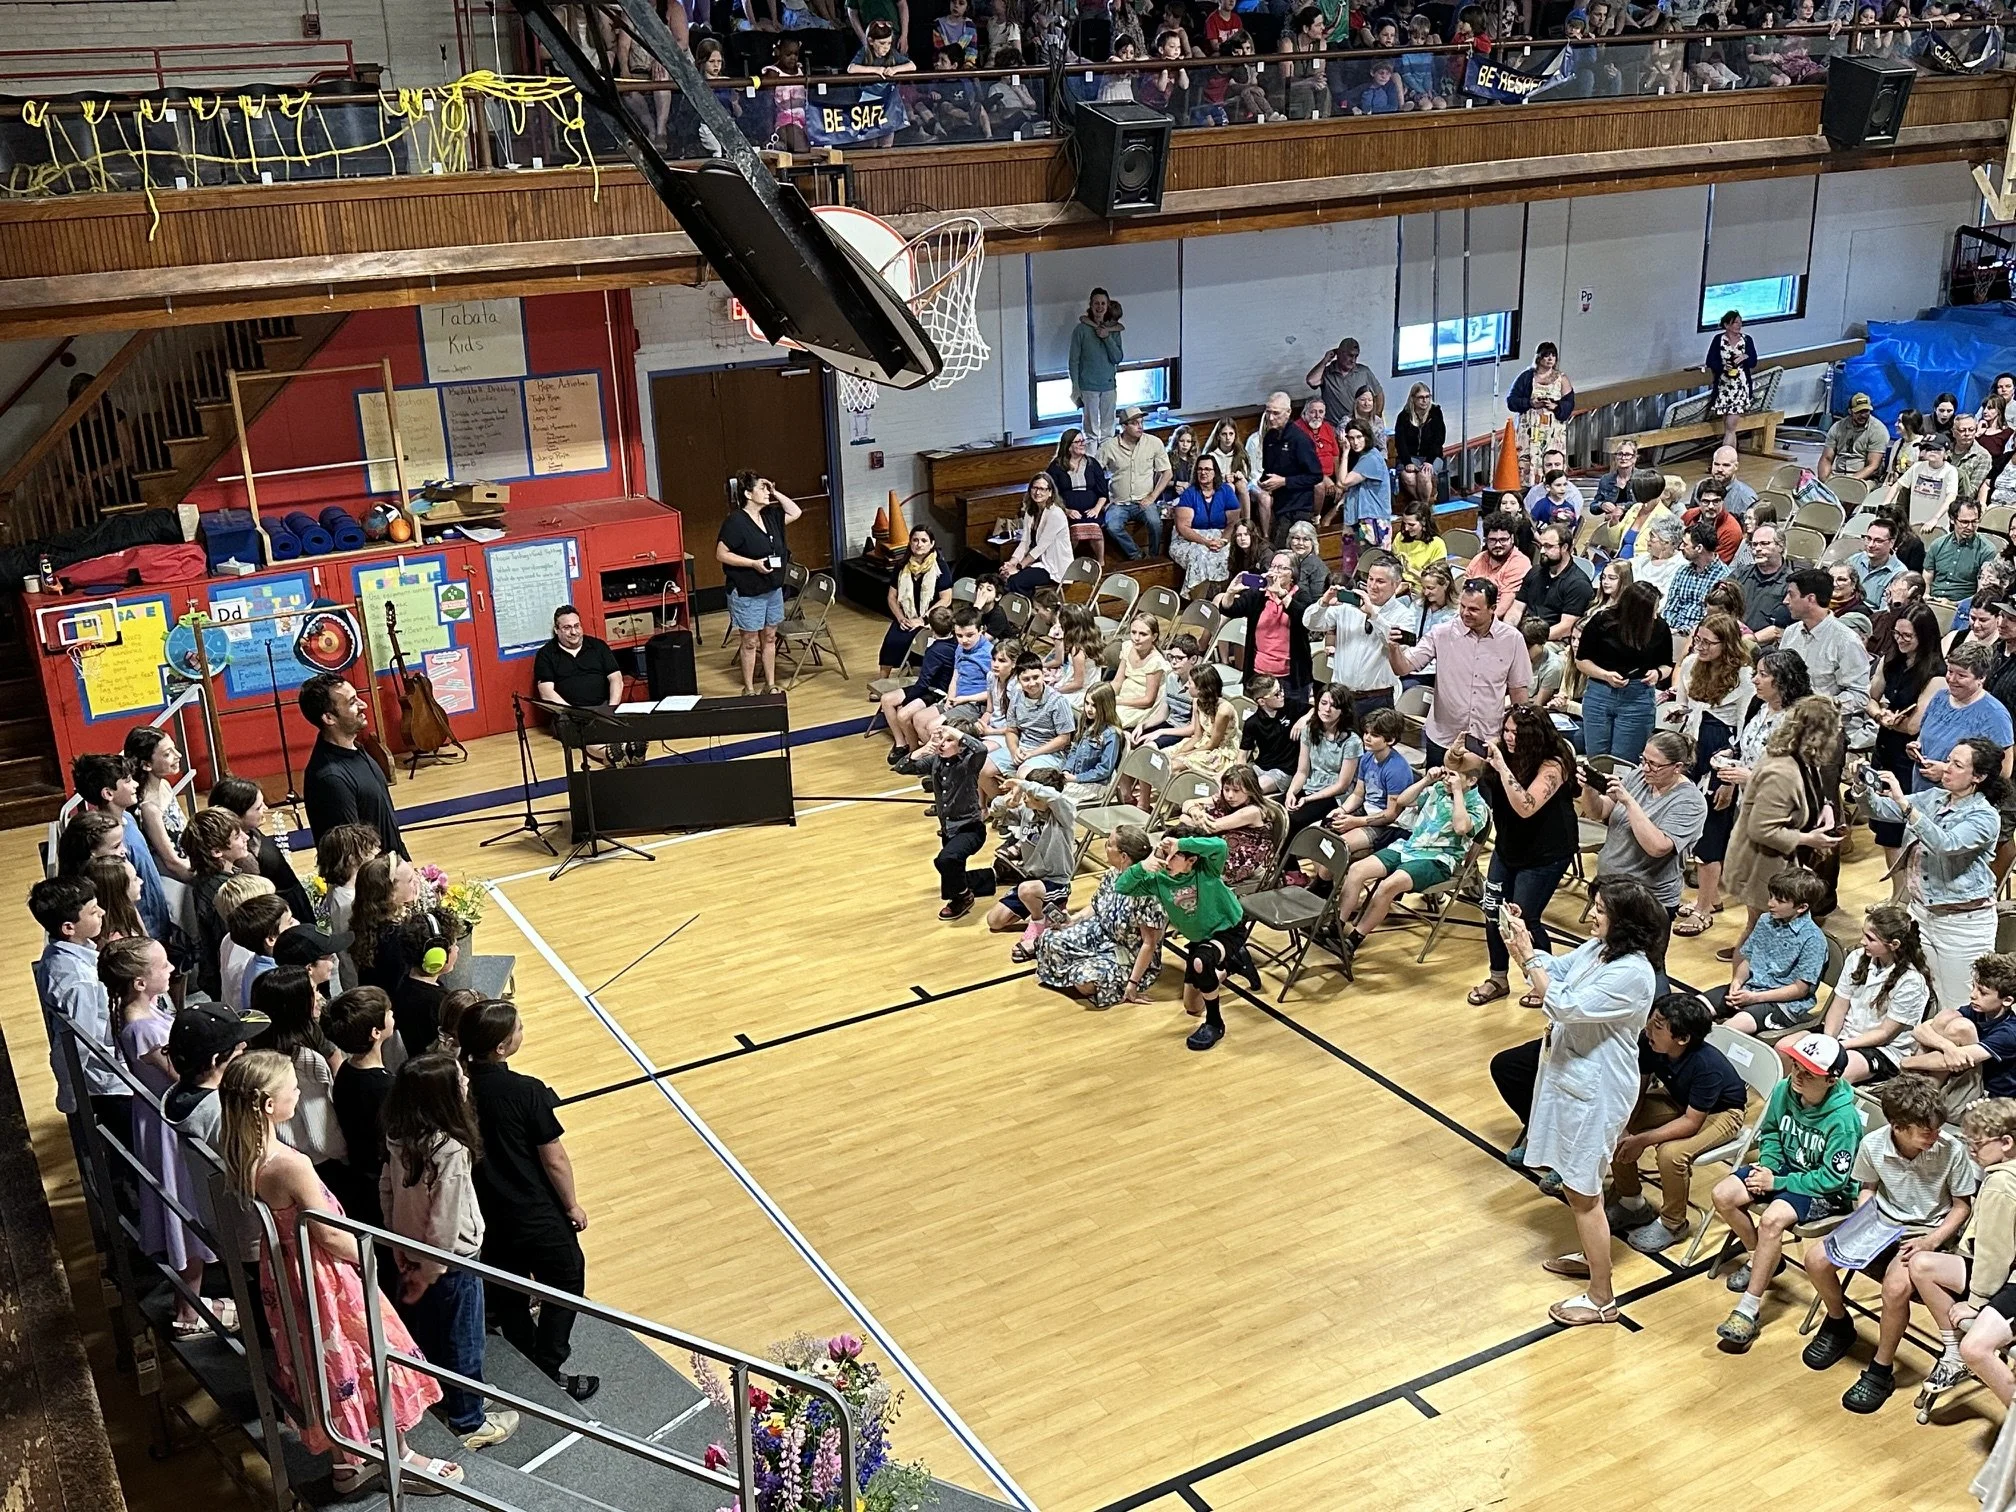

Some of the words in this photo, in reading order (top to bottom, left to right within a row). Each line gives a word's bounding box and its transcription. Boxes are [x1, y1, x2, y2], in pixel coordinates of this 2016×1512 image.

[1477, 65, 1497, 88] BE
[823, 108, 846, 133] BE
[851, 105, 888, 131] SAFE
[1581, 290, 1593, 302] Pp
[430, 302, 498, 327] Tabata
[449, 334, 484, 355] Kids
[218, 605, 242, 622] Dd
